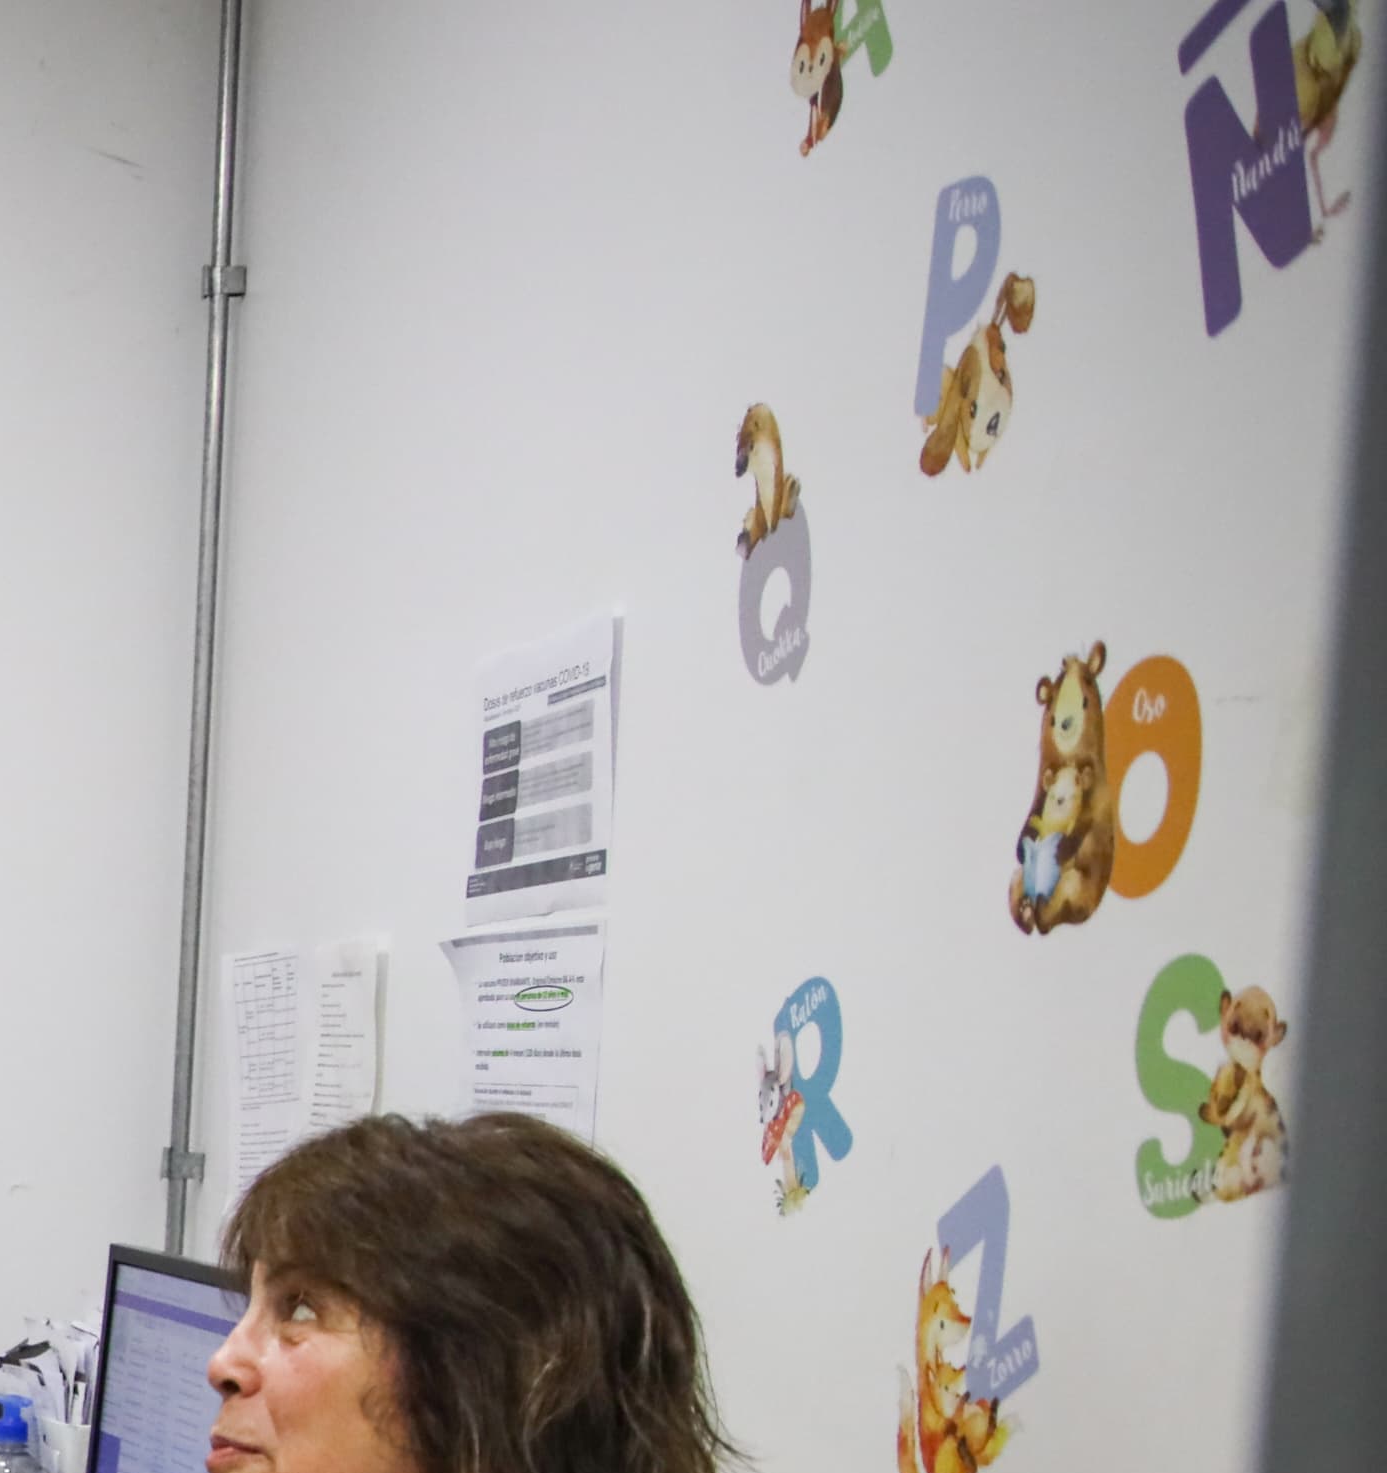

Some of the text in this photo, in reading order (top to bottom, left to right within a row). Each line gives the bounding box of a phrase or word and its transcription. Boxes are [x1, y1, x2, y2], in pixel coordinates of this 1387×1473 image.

[914, 175, 1002, 417] P
[739, 500, 812, 686] Q
[1132, 686, 1167, 725] Oso
[1104, 654, 1203, 900] O
[773, 975, 853, 1192] R
[1135, 953, 1227, 1219] S
